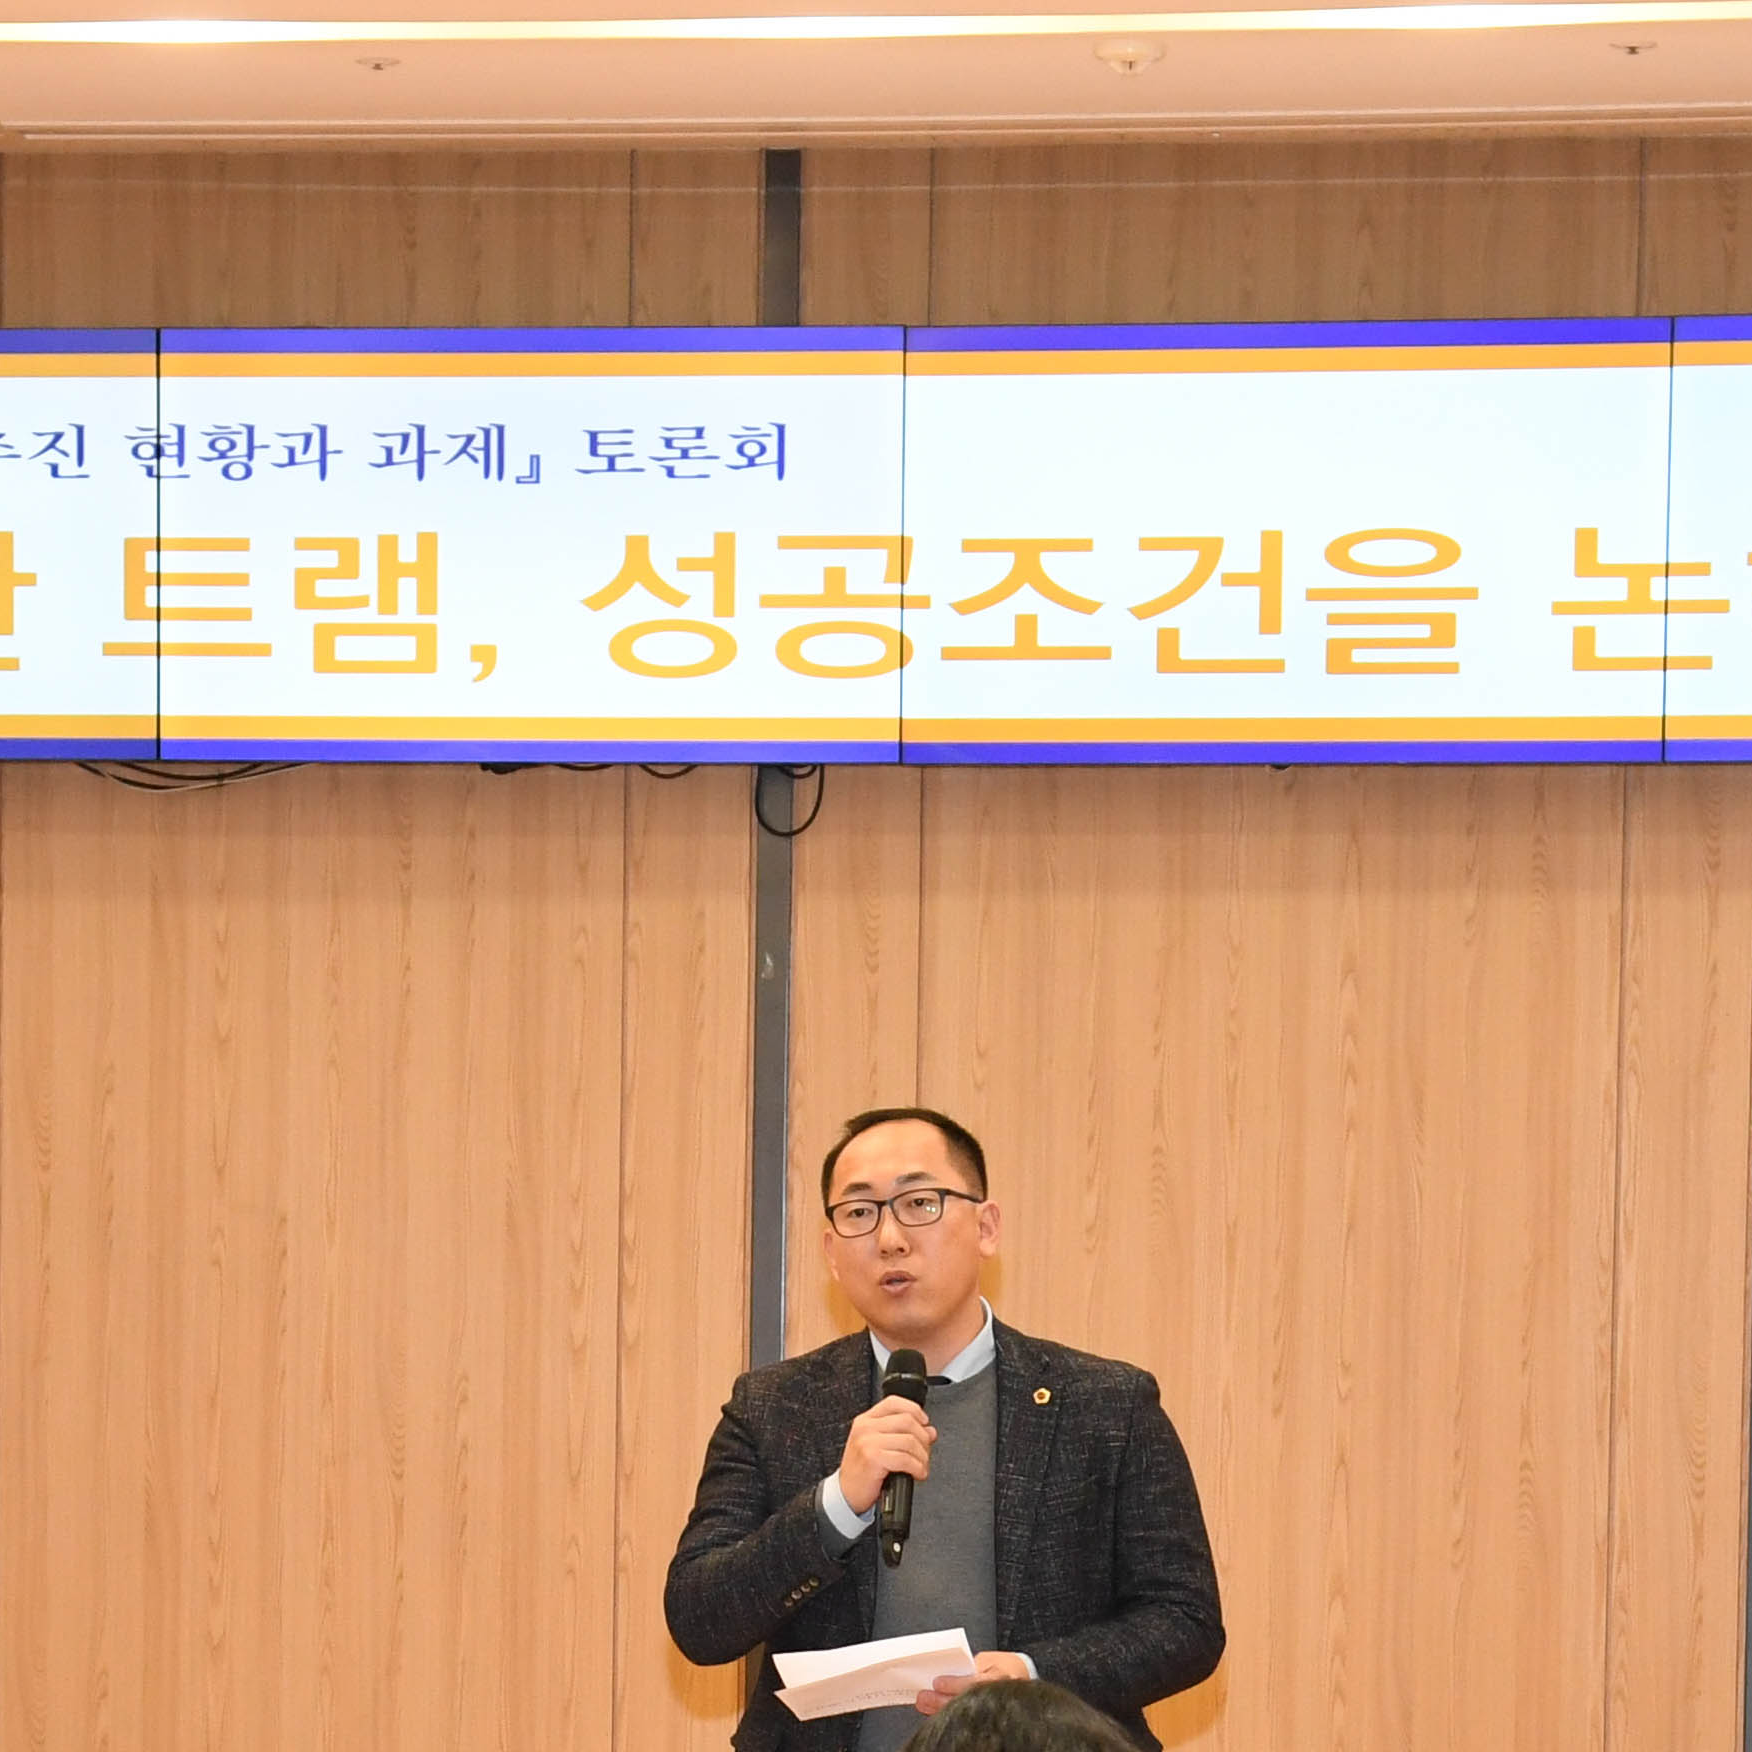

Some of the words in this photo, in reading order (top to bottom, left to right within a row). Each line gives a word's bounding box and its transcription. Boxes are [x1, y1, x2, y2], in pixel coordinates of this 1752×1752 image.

[125, 423, 343, 482] 현황과
[369, 423, 541, 485] 과제』
[575, 423, 786, 482] 토론회
[103, 531, 498, 682] 트램,
[583, 528, 1479, 679] 성공조건을
